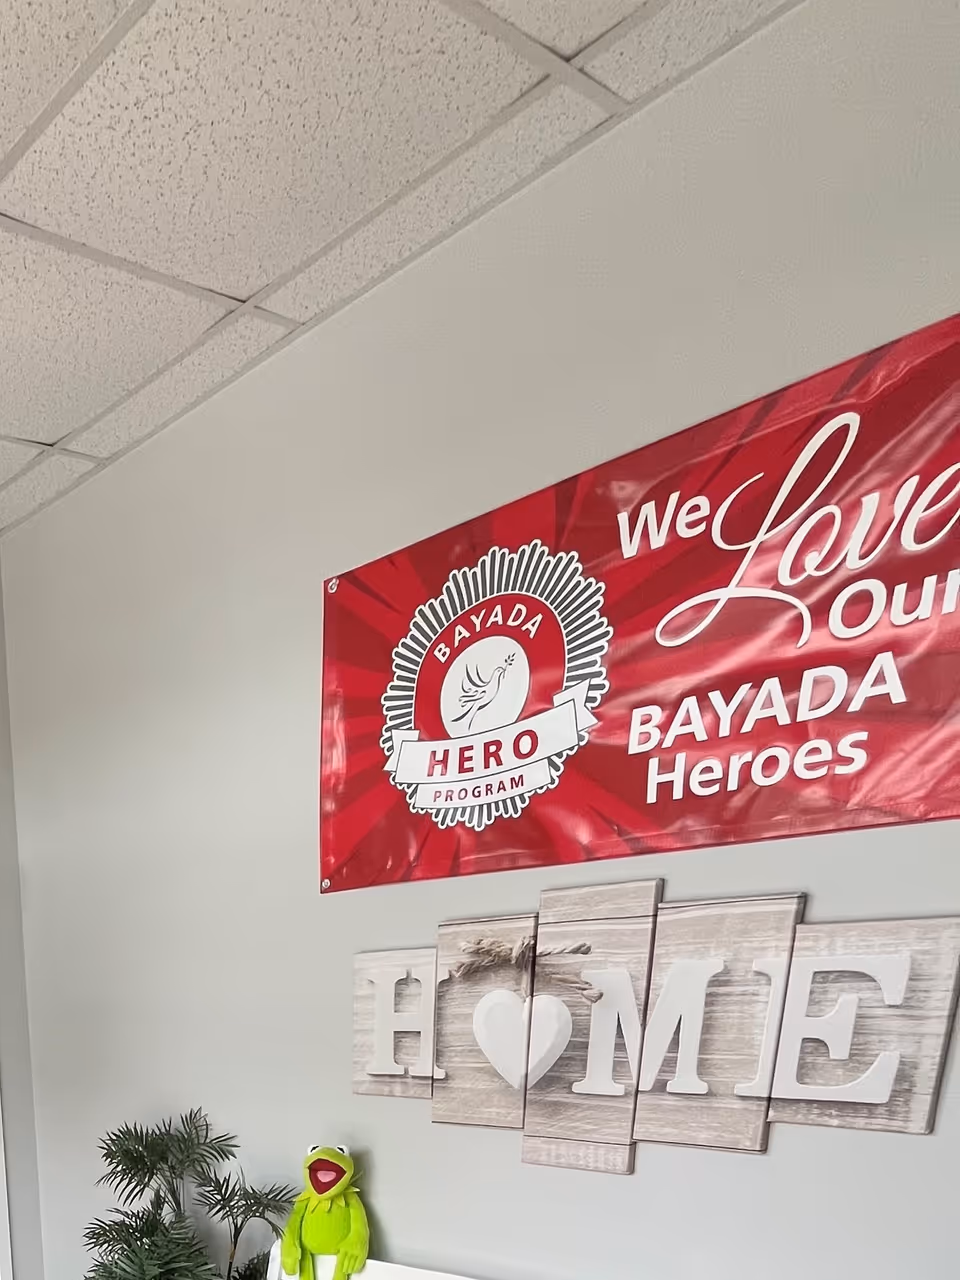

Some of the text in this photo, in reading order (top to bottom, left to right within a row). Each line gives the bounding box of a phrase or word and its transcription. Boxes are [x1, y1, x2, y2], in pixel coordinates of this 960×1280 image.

[616, 412, 960, 648] We Love
[433, 603, 544, 663] BAYADA
[828, 569, 960, 639] Our
[627, 652, 908, 755] BAYADA
[426, 729, 539, 777] HERO
[645, 730, 870, 805] Heroes
[432, 774, 525, 803] PROGRAM
